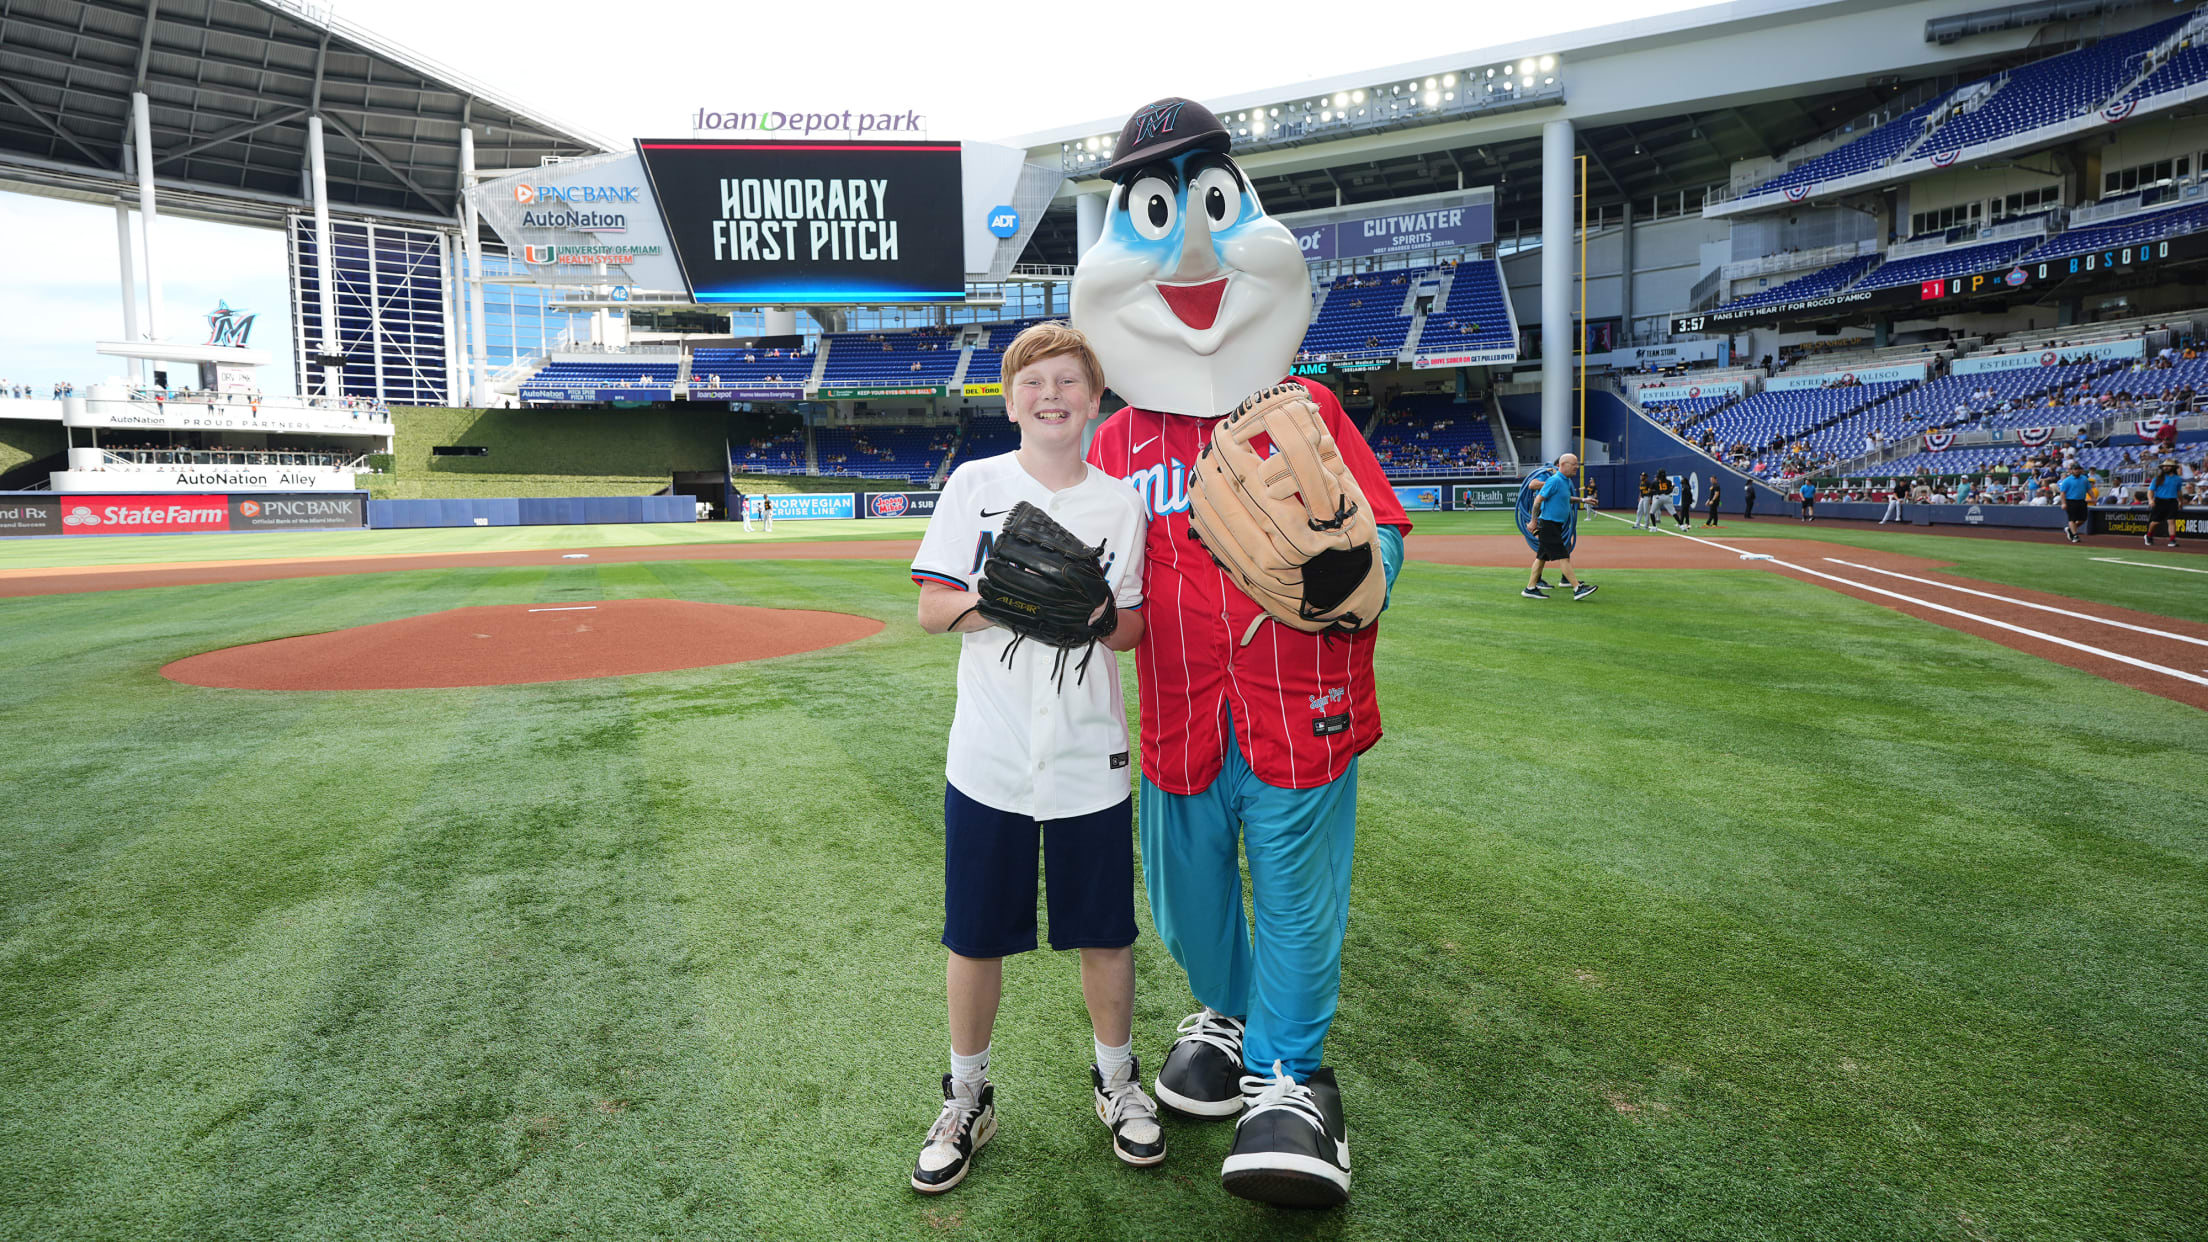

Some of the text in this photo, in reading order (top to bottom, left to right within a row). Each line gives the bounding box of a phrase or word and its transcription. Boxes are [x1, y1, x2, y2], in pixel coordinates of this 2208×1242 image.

[698, 107, 921, 136] loanDepot park
[720, 178, 888, 220] HONORARY
[523, 210, 625, 226] AutoNation
[991, 215, 1016, 228] ADT
[1363, 208, 1462, 238] CUTWATER
[712, 220, 899, 261] FIRST PITCH
[1392, 232, 1432, 246] SPIRITS
[558, 246, 661, 255] UNIVERSITY OF MIAMI
[559, 255, 633, 264] HEALTH SYSTEM
[1972, 276, 1984, 292] P
[2070, 258, 2078, 273] B
[2104, 252, 2113, 267] S
[614, 290, 626, 298] 42
[1713, 291, 1872, 321] FANS LET'S HEAR IT FOR ROCCO D'AMICO
[1679, 316, 1705, 333] 3:57
[1499, 353, 1515, 361] OVER
[1646, 348, 1677, 358] TEAM STORE
[1298, 363, 1327, 375] AMG
[1979, 357, 2038, 370] ESTRELLA
[522, 390, 564, 398] AutoNation
[697, 391, 732, 399] loanDepot
[981, 386, 1000, 394] TORO
[1643, 385, 1739, 399] ESTRELLA JALISCO
[110, 416, 311, 429] AutoNation PROUD PARTNERS
[176, 473, 316, 487] AutoNation Alley
[771, 498, 851, 508] NORWEGIAN
[910, 500, 934, 509] A SUB
[771, 507, 836, 516] CRUISE LINE
[2186, 520, 2197, 533] ARE
